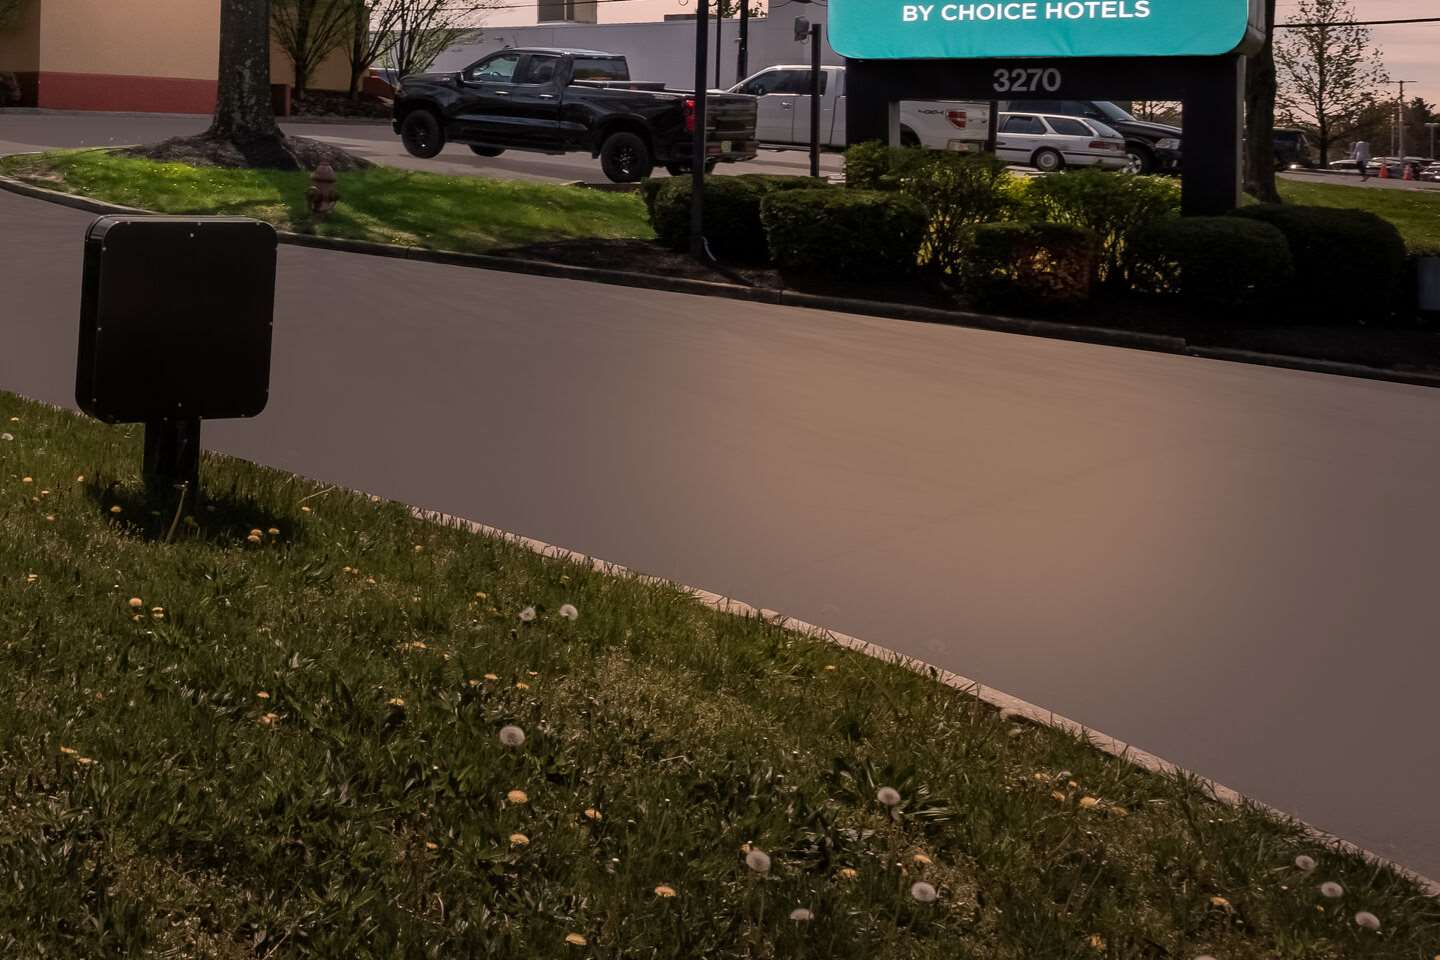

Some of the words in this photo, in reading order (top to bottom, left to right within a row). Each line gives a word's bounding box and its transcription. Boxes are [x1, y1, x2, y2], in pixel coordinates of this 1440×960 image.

[902, 5, 934, 22] BY
[940, 2, 1038, 21] CHOICE
[1045, 0, 1151, 20] HOTELS
[993, 68, 1061, 92] 3270
